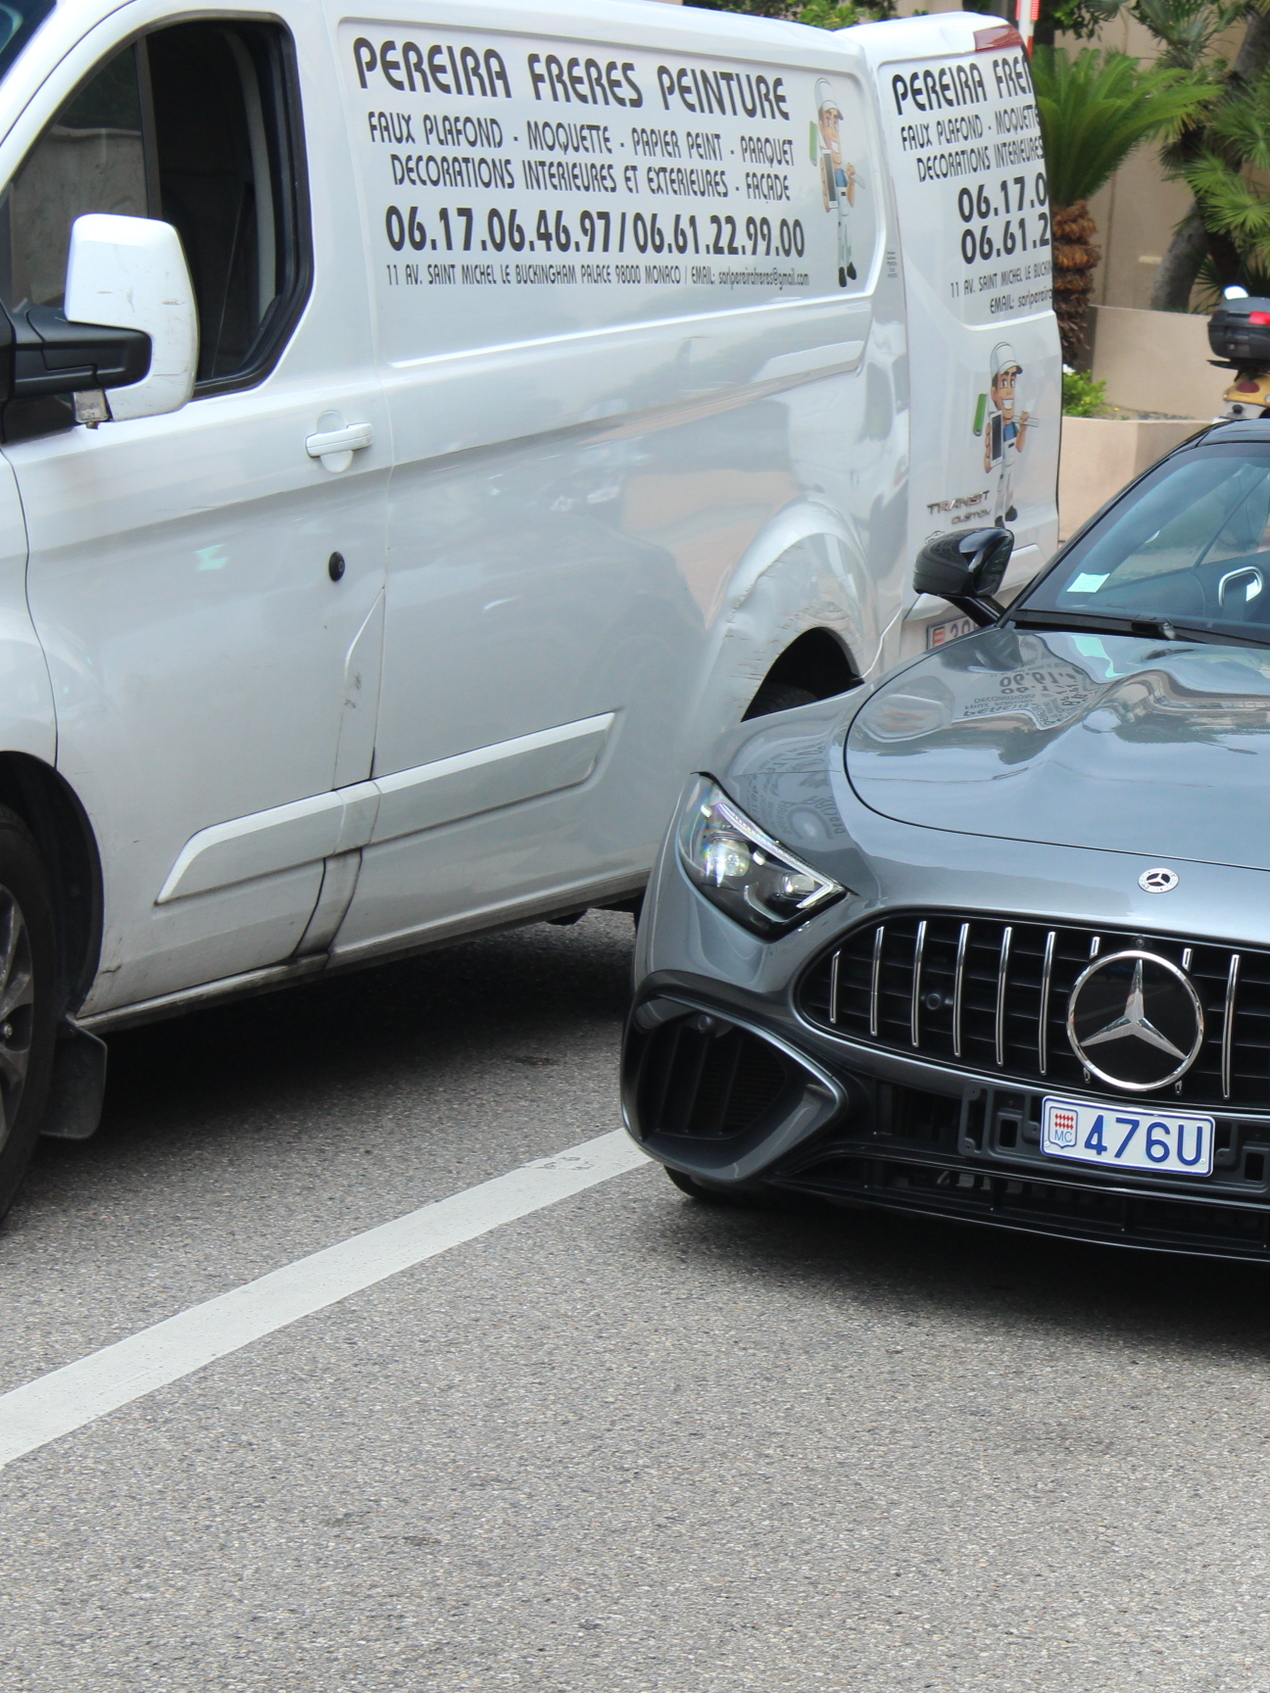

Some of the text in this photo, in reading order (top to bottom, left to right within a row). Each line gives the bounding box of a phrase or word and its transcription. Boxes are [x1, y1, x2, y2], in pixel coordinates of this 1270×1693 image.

[354, 37, 789, 120] PEREIRA FRERES PEINTURE
[892, 63, 987, 115] PEREIRA
[368, 112, 415, 144] FAUX
[424, 114, 502, 148] PLAFOND
[527, 121, 612, 154] MOQUETTE
[632, 128, 681, 158] PAPIER
[687, 132, 722, 160] PEINT
[741, 136, 793, 167] PARQUET
[901, 124, 932, 150] FAUX
[937, 114, 982, 144] PLAFOND
[391, 154, 514, 188] DECORATIONS
[522, 160, 616, 192] INTERIEURES
[624, 166, 638, 193] ET
[647, 166, 728, 197] EXTERIEURES
[746, 172, 790, 203] FAÇADE
[917, 136, 1044, 182] DECORATIONS INTERIEURES
[958, 172, 1045, 222] 06.17.0
[962, 212, 1050, 264] 06.61.2
[387, 265, 398, 285] 11
[406, 264, 422, 284] AV.
[428, 264, 455, 284] SAINT
[462, 265, 496, 284] MICHEL
[501, 265, 510, 284] LE
[516, 264, 576, 284] BUCKINGHAM
[581, 264, 611, 283] PALACE
[616, 265, 640, 284] 98000
[645, 265, 680, 284] MONACO
[692, 266, 715, 285] EMAIL:
[951, 282, 958, 297] 11
[965, 280, 976, 294] AV.
[979, 273, 997, 291] SAINT
[1002, 268, 1022, 285] MICHEL
[1025, 265, 1031, 280] LE
[1054, 1129, 1073, 1143] MC
[1084, 1114, 1203, 1166] 476U
